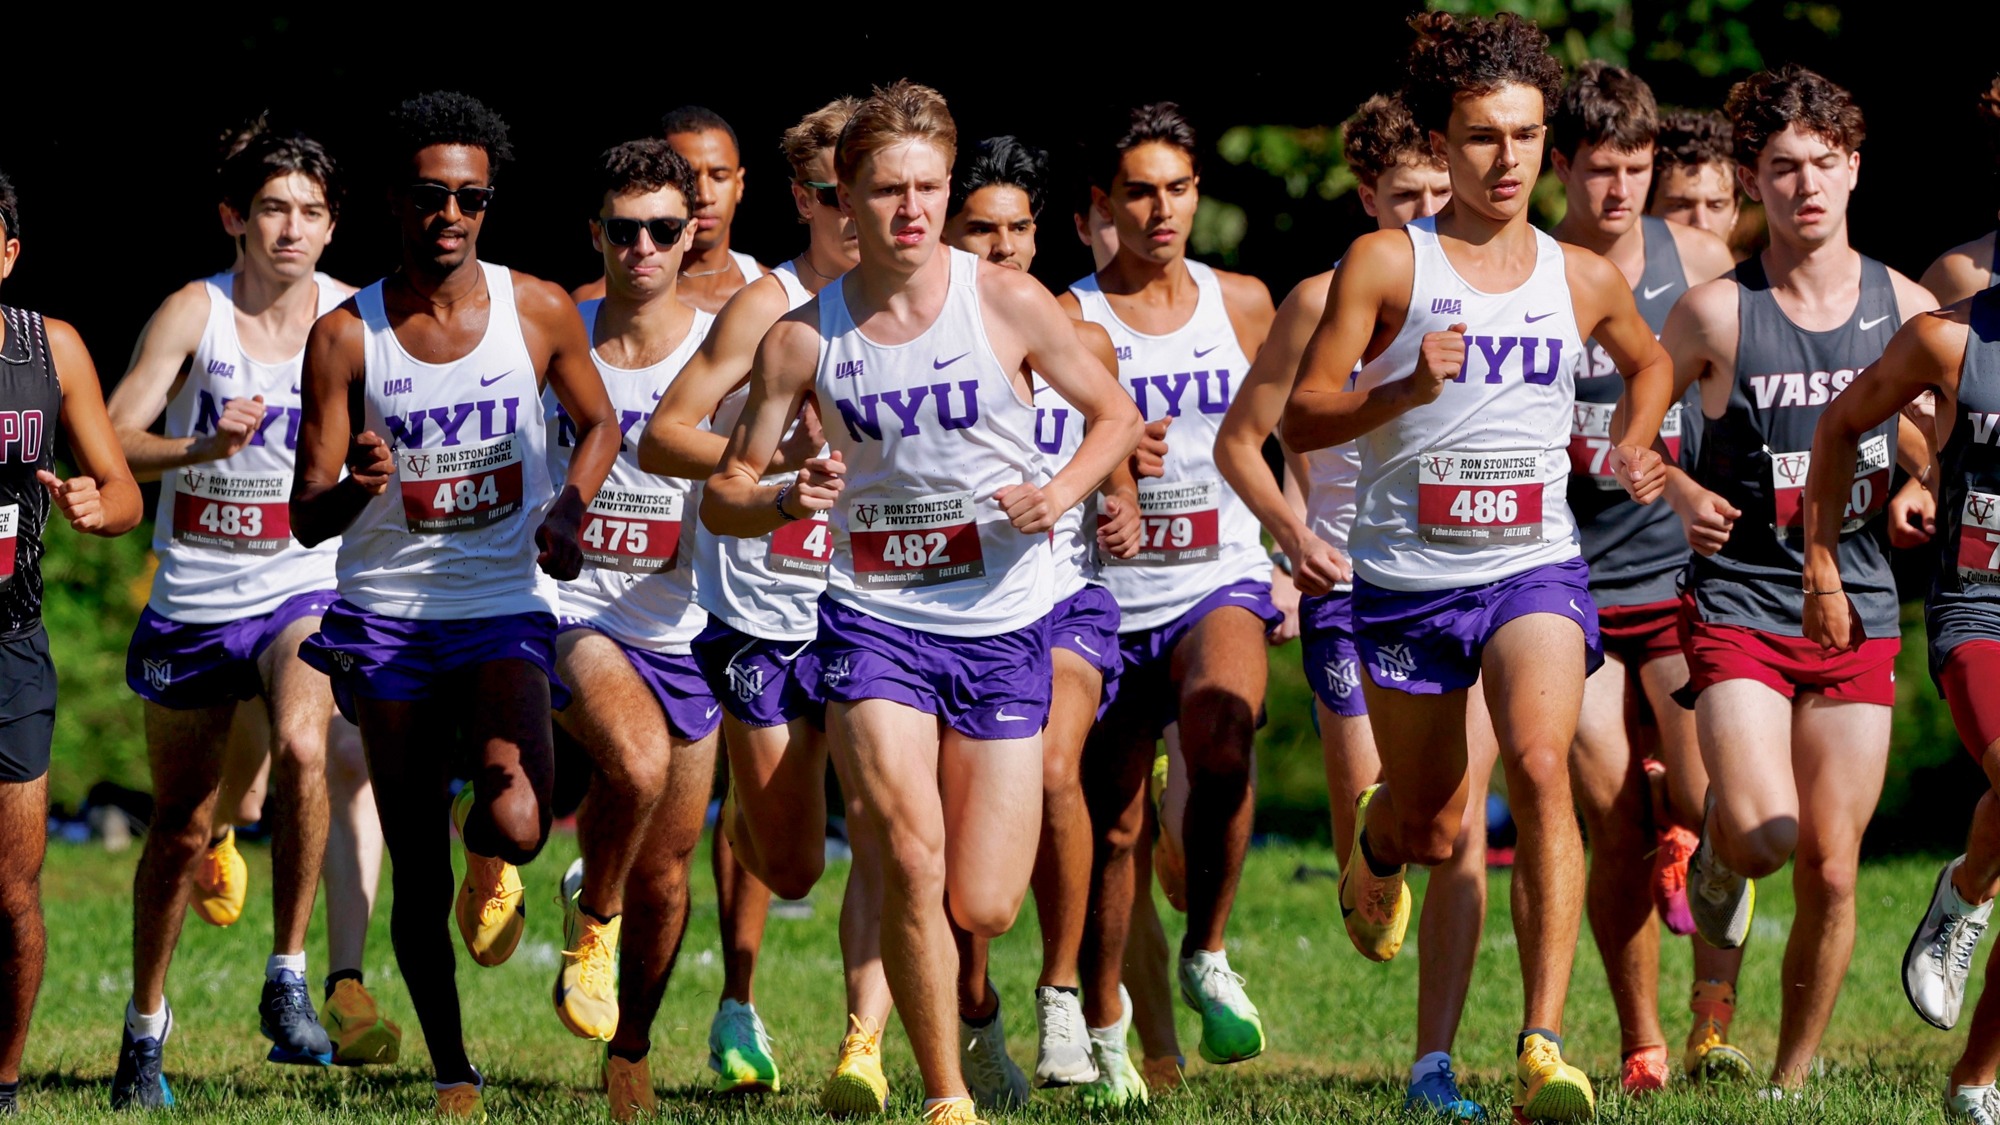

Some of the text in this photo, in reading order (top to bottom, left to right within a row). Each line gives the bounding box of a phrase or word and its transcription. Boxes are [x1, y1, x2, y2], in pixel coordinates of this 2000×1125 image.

[1431, 298, 1462, 315] UAA
[207, 360, 235, 379] UAA
[836, 360, 863, 379] UAA
[384, 377, 412, 396] UAA
[1749, 368, 1865, 409] VASS
[836, 379, 979, 443] NYU
[385, 397, 519, 449] NYU
[436, 452, 457, 464] RON
[458, 440, 512, 461] STONITSCH
[437, 451, 513, 474] INVITATIONAL
[1459, 458, 1482, 470] RON
[1483, 456, 1536, 470] STONITSCH
[208, 475, 228, 486] RON
[229, 478, 284, 489] STONITSCH
[1459, 469, 1536, 480] INVITATIONAL
[208, 485, 283, 498] INVITATIONAL
[433, 474, 499, 514] 484
[616, 492, 673, 506] STONITSCH
[1156, 485, 1208, 501] STONITSCH
[593, 500, 671, 515] INVITATIONAL
[883, 504, 904, 515] RON
[905, 499, 963, 514] STONITSCH
[1140, 496, 1208, 511] NVITATIONAL
[1449, 489, 1518, 524] 486
[199, 502, 263, 537] 483
[885, 510, 965, 526] INVITATIONAL
[582, 517, 649, 554] 475
[1431, 527, 1448, 536] Fulton
[1448, 528, 1472, 537] Accurate
[1472, 529, 1490, 538] Timing
[882, 532, 951, 567] 482
[782, 558, 799, 569] Fulton
[800, 560, 821, 573] Accurate
[868, 573, 885, 583] Fulton
[885, 572, 907, 582] Accurate
[1967, 570, 1988, 584] Fulton
